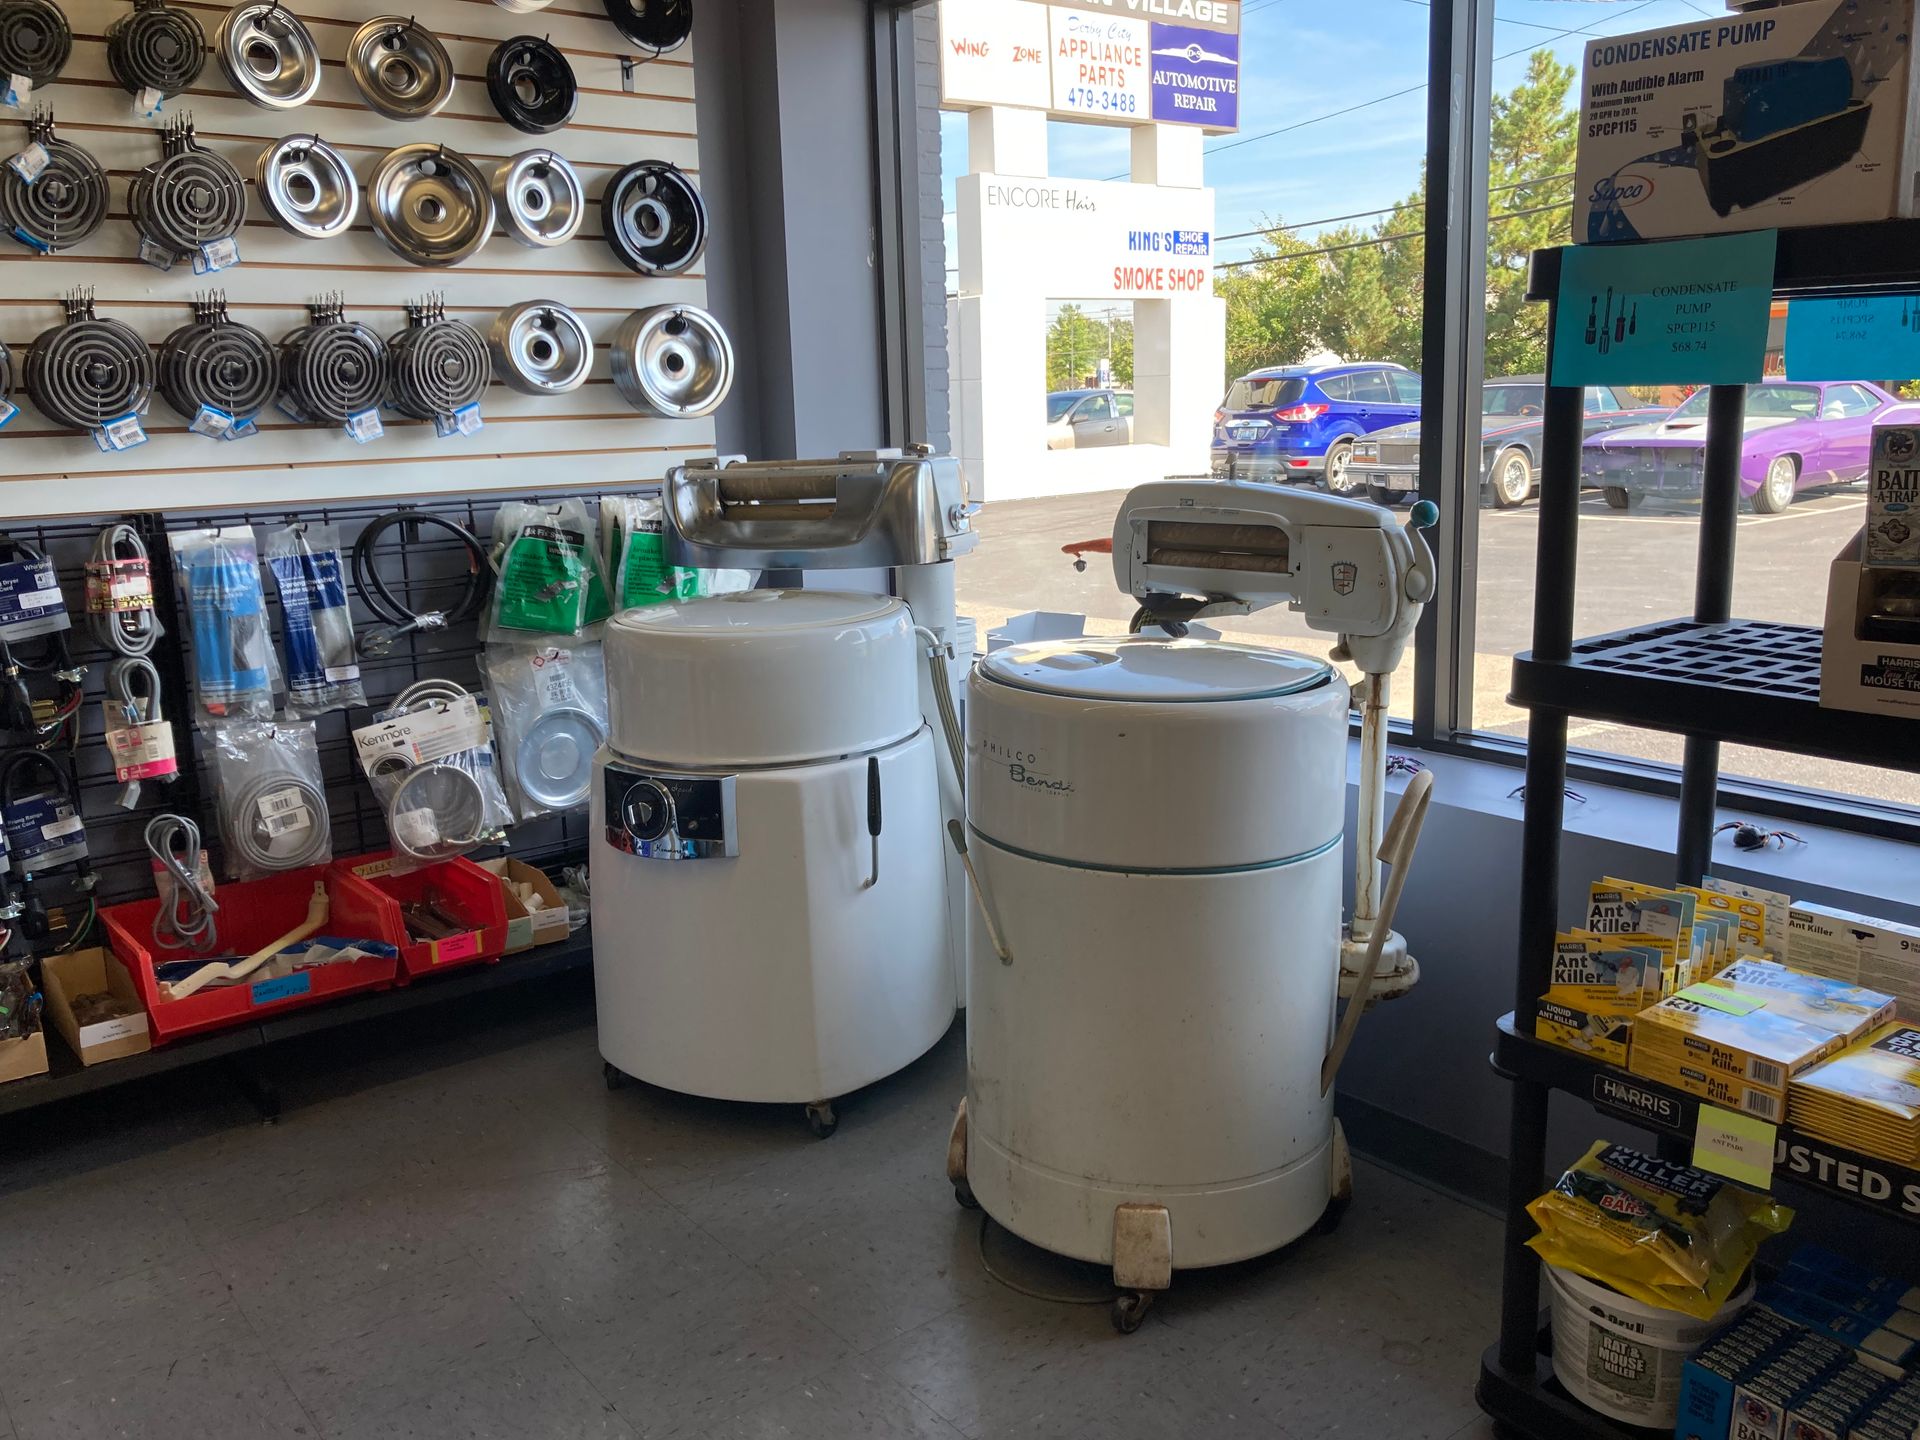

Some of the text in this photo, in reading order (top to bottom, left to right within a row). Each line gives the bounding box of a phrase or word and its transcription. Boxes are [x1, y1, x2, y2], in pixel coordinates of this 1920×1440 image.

[1068, 16, 1132, 42] Derby City
[950, 37, 1042, 63] WING ZONE
[1059, 37, 1141, 66] APPLIANCE
[1592, 19, 1775, 67] CONDENSATE PUMP
[1079, 64, 1125, 88] PARTS
[1152, 69, 1237, 94] AUTOMOTIVE
[1592, 70, 1704, 97] With Audible Alarm
[1068, 88, 1136, 112] 479-3488
[1174, 93, 1217, 112] REPAIR
[1623, 94, 1642, 104] Work
[1589, 119, 1637, 137] SPCP115
[988, 185, 1096, 212] ENCORE Hair
[1129, 231, 1172, 252] KING'S
[1180, 231, 1203, 243] SHOE
[1176, 243, 1207, 255] REPAIR
[1114, 267, 1205, 291] SMOKE SHOP
[1652, 281, 1738, 298] CONDENSATE
[1675, 302, 1711, 315] PUMP
[1666, 321, 1716, 335] SPCP115
[1672, 341, 1707, 353] $68.74
[1882, 657, 1920, 668] HARRIS
[1864, 675, 1905, 688] MOUSE
[358, 727, 411, 748] Kenmore
[983, 739, 1036, 764] PHILCO
[1590, 904, 1623, 918] Ant
[1590, 919, 1640, 933] Killer
[1789, 919, 1833, 937] Ant Killer
[1900, 940, 1909, 950] 9
[1555, 954, 1588, 968] Ant
[1555, 969, 1603, 983] Killer
[1538, 1010, 1578, 1027] ANT KILLER
[1547, 1004, 1571, 1016] LIQUID
[1712, 1048, 1734, 1061] Ant
[1711, 1057, 1743, 1075] Killer
[1708, 1078, 1729, 1091] Ant
[1603, 1080, 1671, 1116] HARRIS
[1707, 1087, 1740, 1105] Killer
[1712, 1138, 1743, 1152] ANT PADS
[1608, 1151, 1711, 1193] KILLER
[1774, 1139, 1891, 1200] USTED
[1601, 1194, 1648, 1217] BARS
[1603, 1336, 1640, 1359] RAT &
[1599, 1347, 1645, 1372] MOUSE
[1604, 1361, 1636, 1379] KILLER
